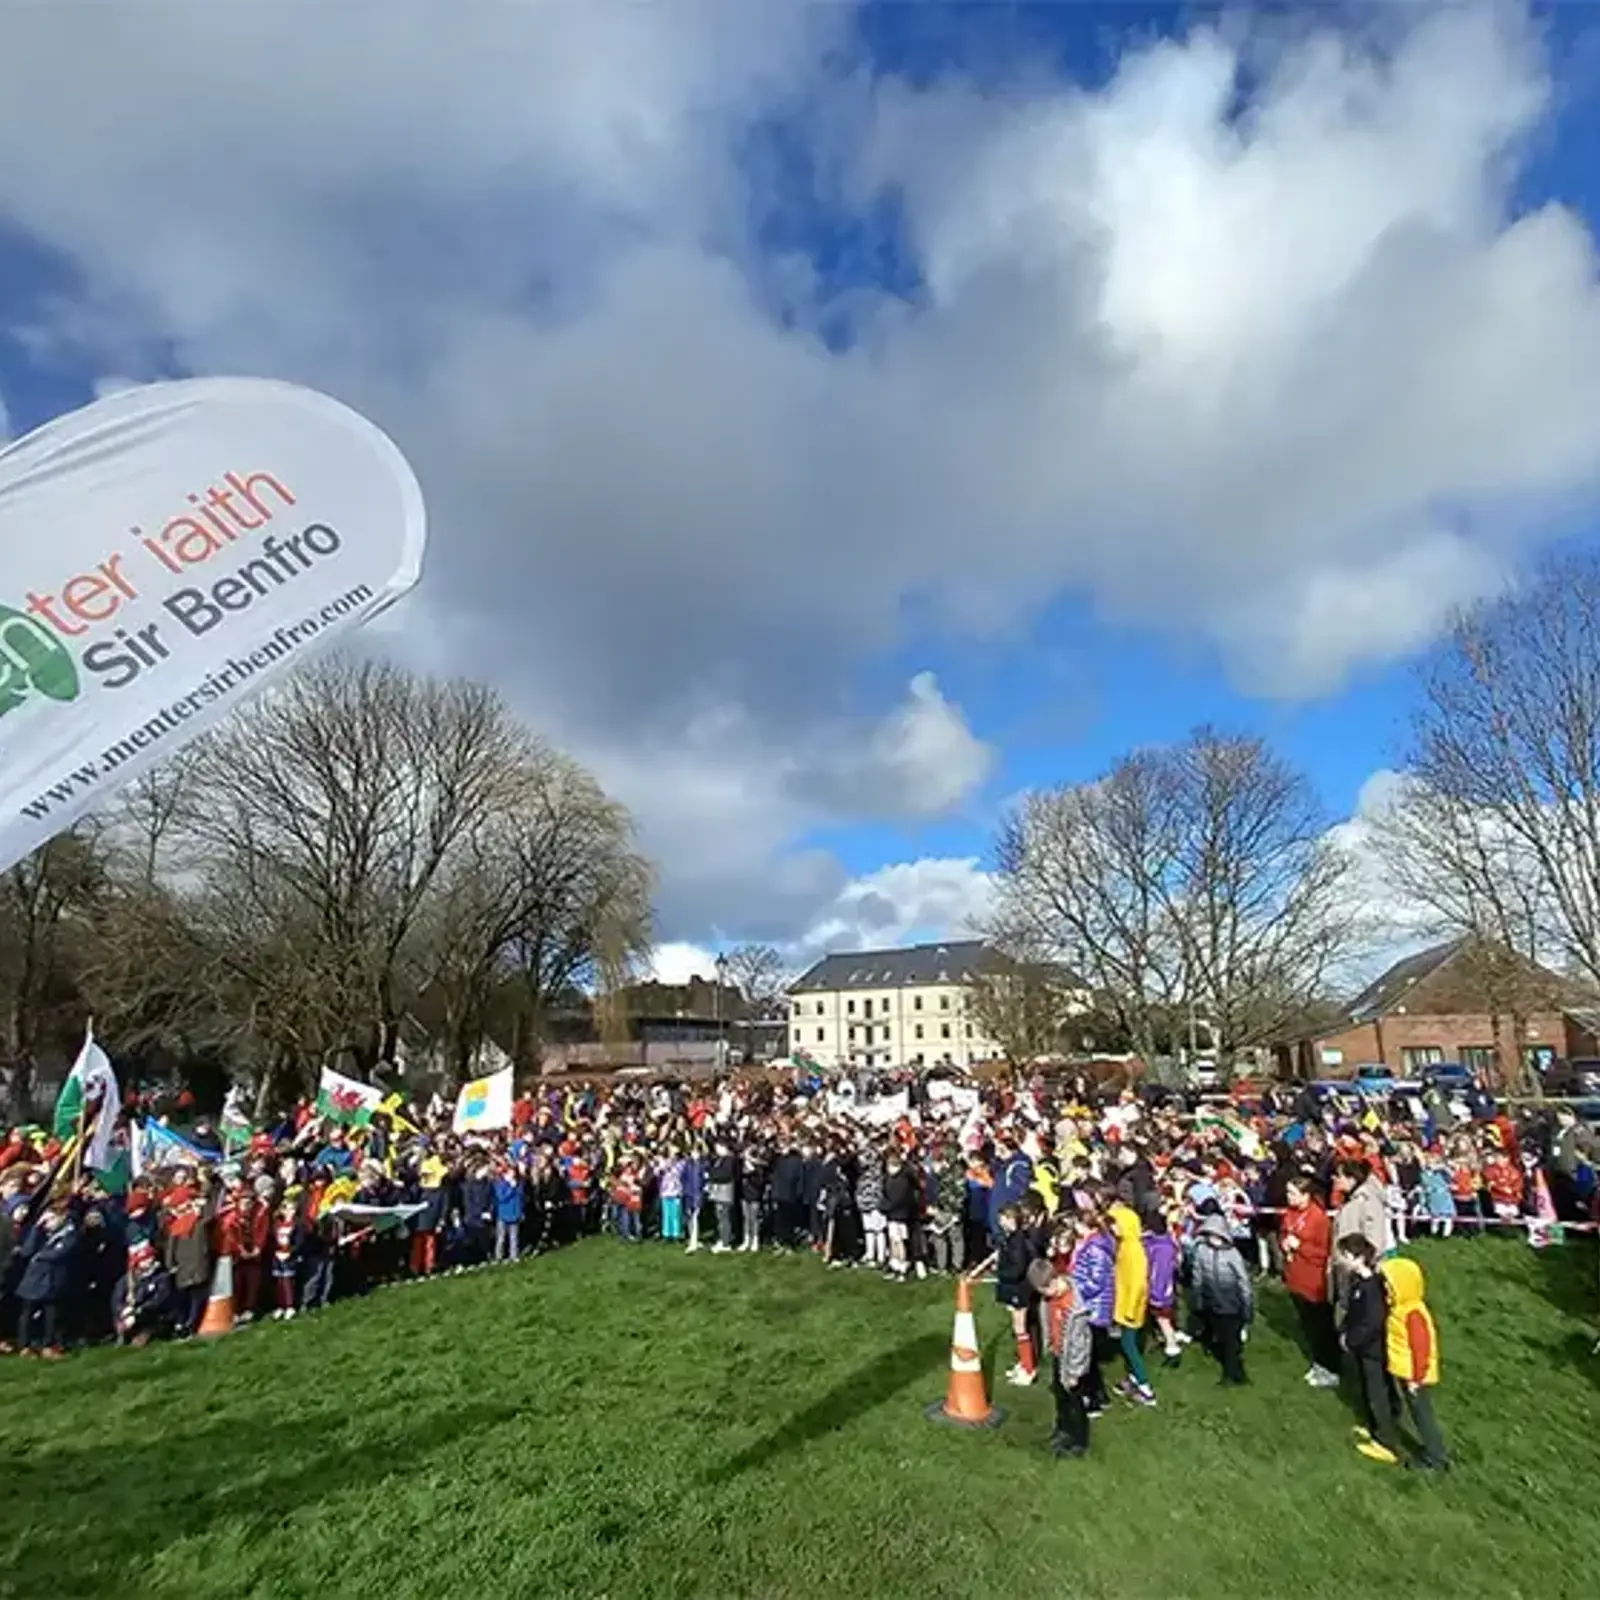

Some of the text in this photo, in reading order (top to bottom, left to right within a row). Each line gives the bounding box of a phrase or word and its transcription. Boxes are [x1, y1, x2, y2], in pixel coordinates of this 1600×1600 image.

[0, 471, 297, 687] nter iaith
[82, 523, 341, 690] Sir Benfro
[19, 583, 374, 822] www.mentersirbenfro.com
